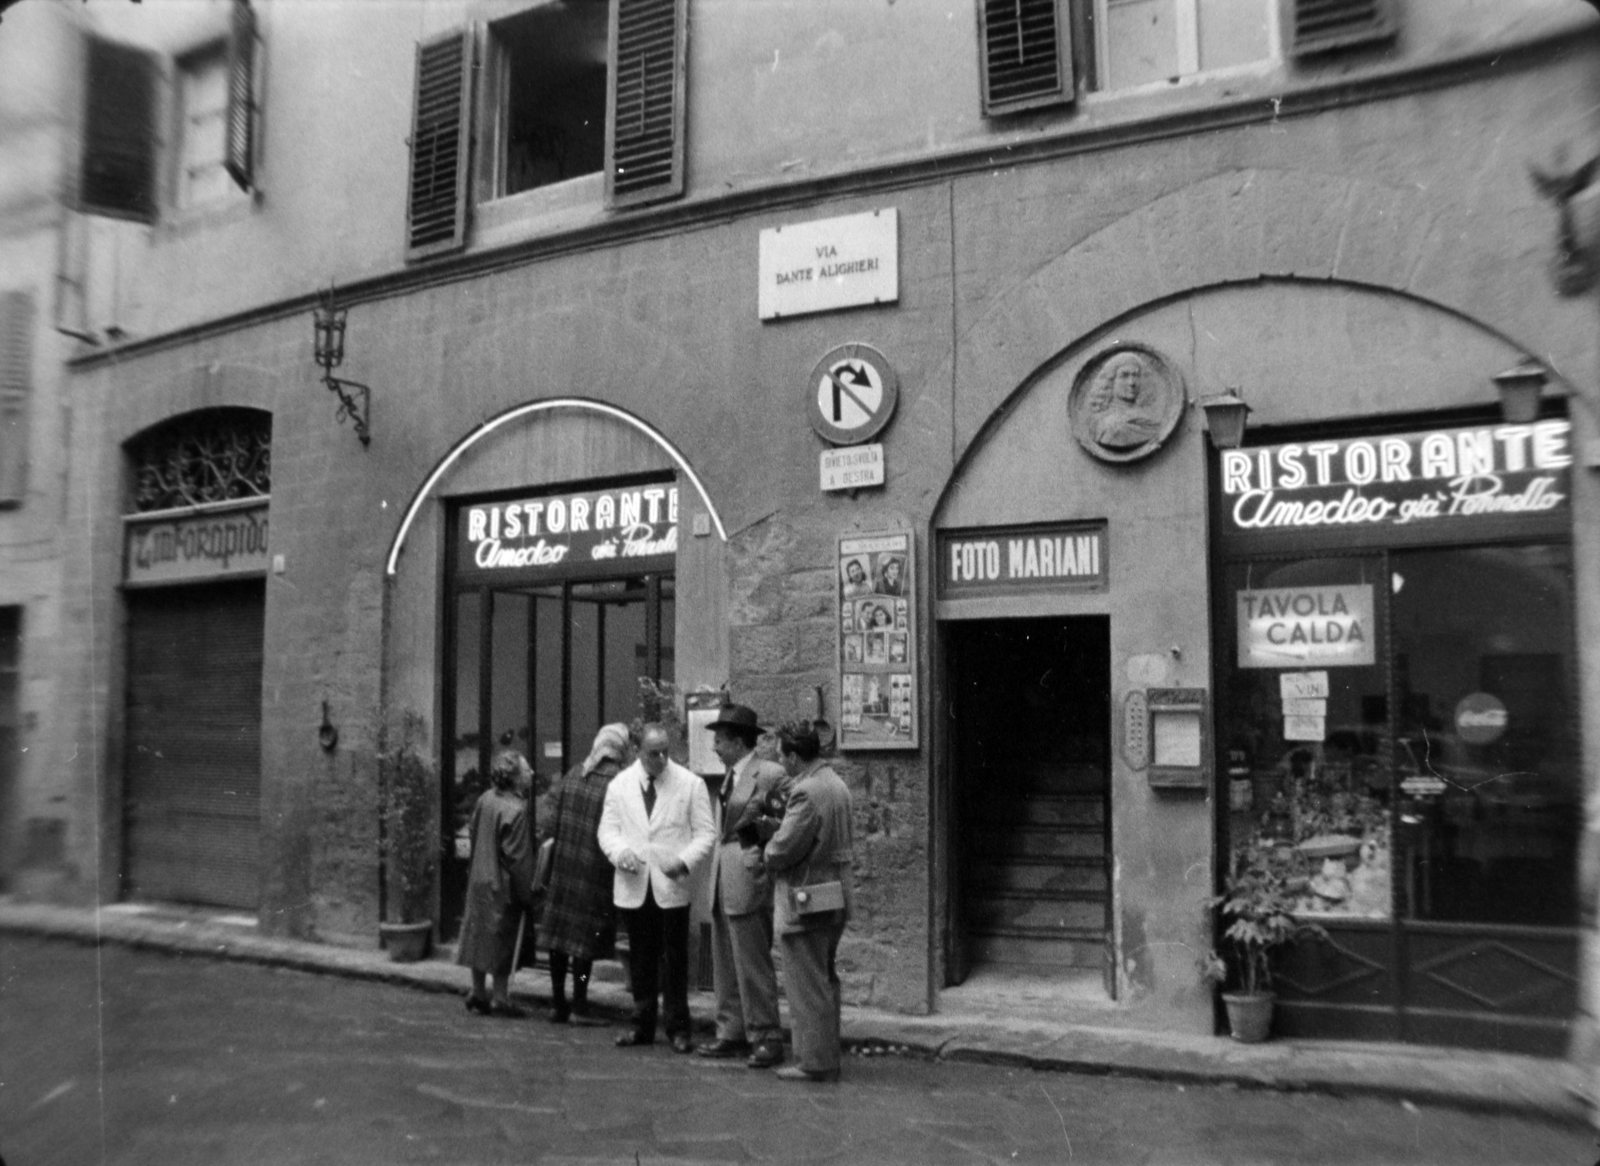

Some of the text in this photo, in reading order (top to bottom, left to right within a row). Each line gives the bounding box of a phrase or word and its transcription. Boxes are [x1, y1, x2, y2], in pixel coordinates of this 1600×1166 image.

[816, 245, 837, 258] VIA
[776, 258, 879, 285] DANTE ALIGHIERI
[852, 451, 878, 467] SVOLTA
[1223, 419, 1573, 494] RISTORANTE
[829, 469, 875, 486] A DESTRA
[1233, 488, 1396, 528] Amedeo
[1393, 489, 1447, 524] già
[475, 538, 570, 568] Amedeo
[951, 535, 1099, 581] FOTO MARIANI
[1243, 592, 1349, 619] TAVOLA
[1266, 619, 1365, 645] CALDA
